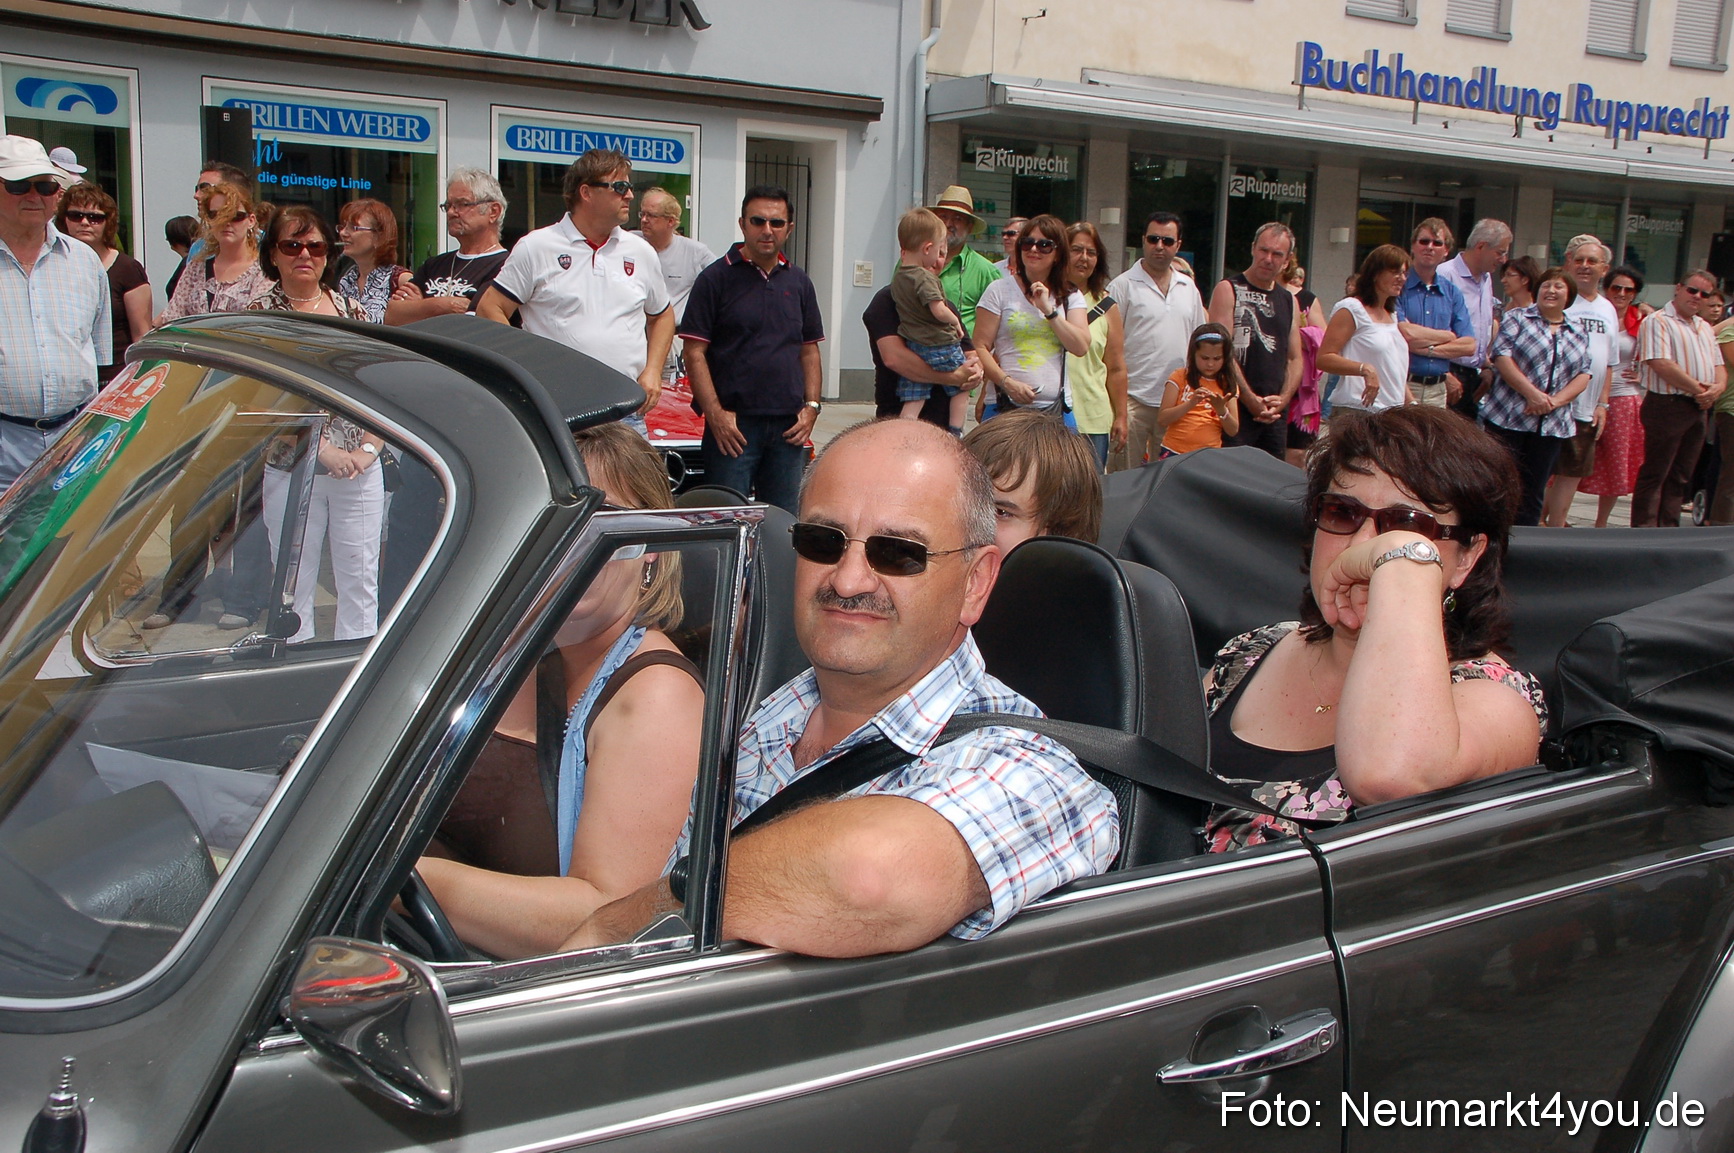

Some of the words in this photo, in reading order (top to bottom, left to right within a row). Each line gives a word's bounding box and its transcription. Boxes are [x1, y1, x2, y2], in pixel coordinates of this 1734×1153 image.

[1298, 40, 1562, 131] Buchhandlung
[1567, 83, 1731, 142] Rupprecht
[234, 101, 331, 132] RILLEN
[337, 111, 422, 140] WEBER
[517, 127, 600, 153] BRILLEN
[604, 135, 677, 162] WEBER
[996, 151, 1069, 175] Rupprecht
[257, 171, 278, 184] die
[281, 173, 337, 190] günstige
[340, 178, 372, 190] Linie
[1247, 176, 1307, 200] Rupprecht
[1639, 215, 1684, 234] Rupprecht
